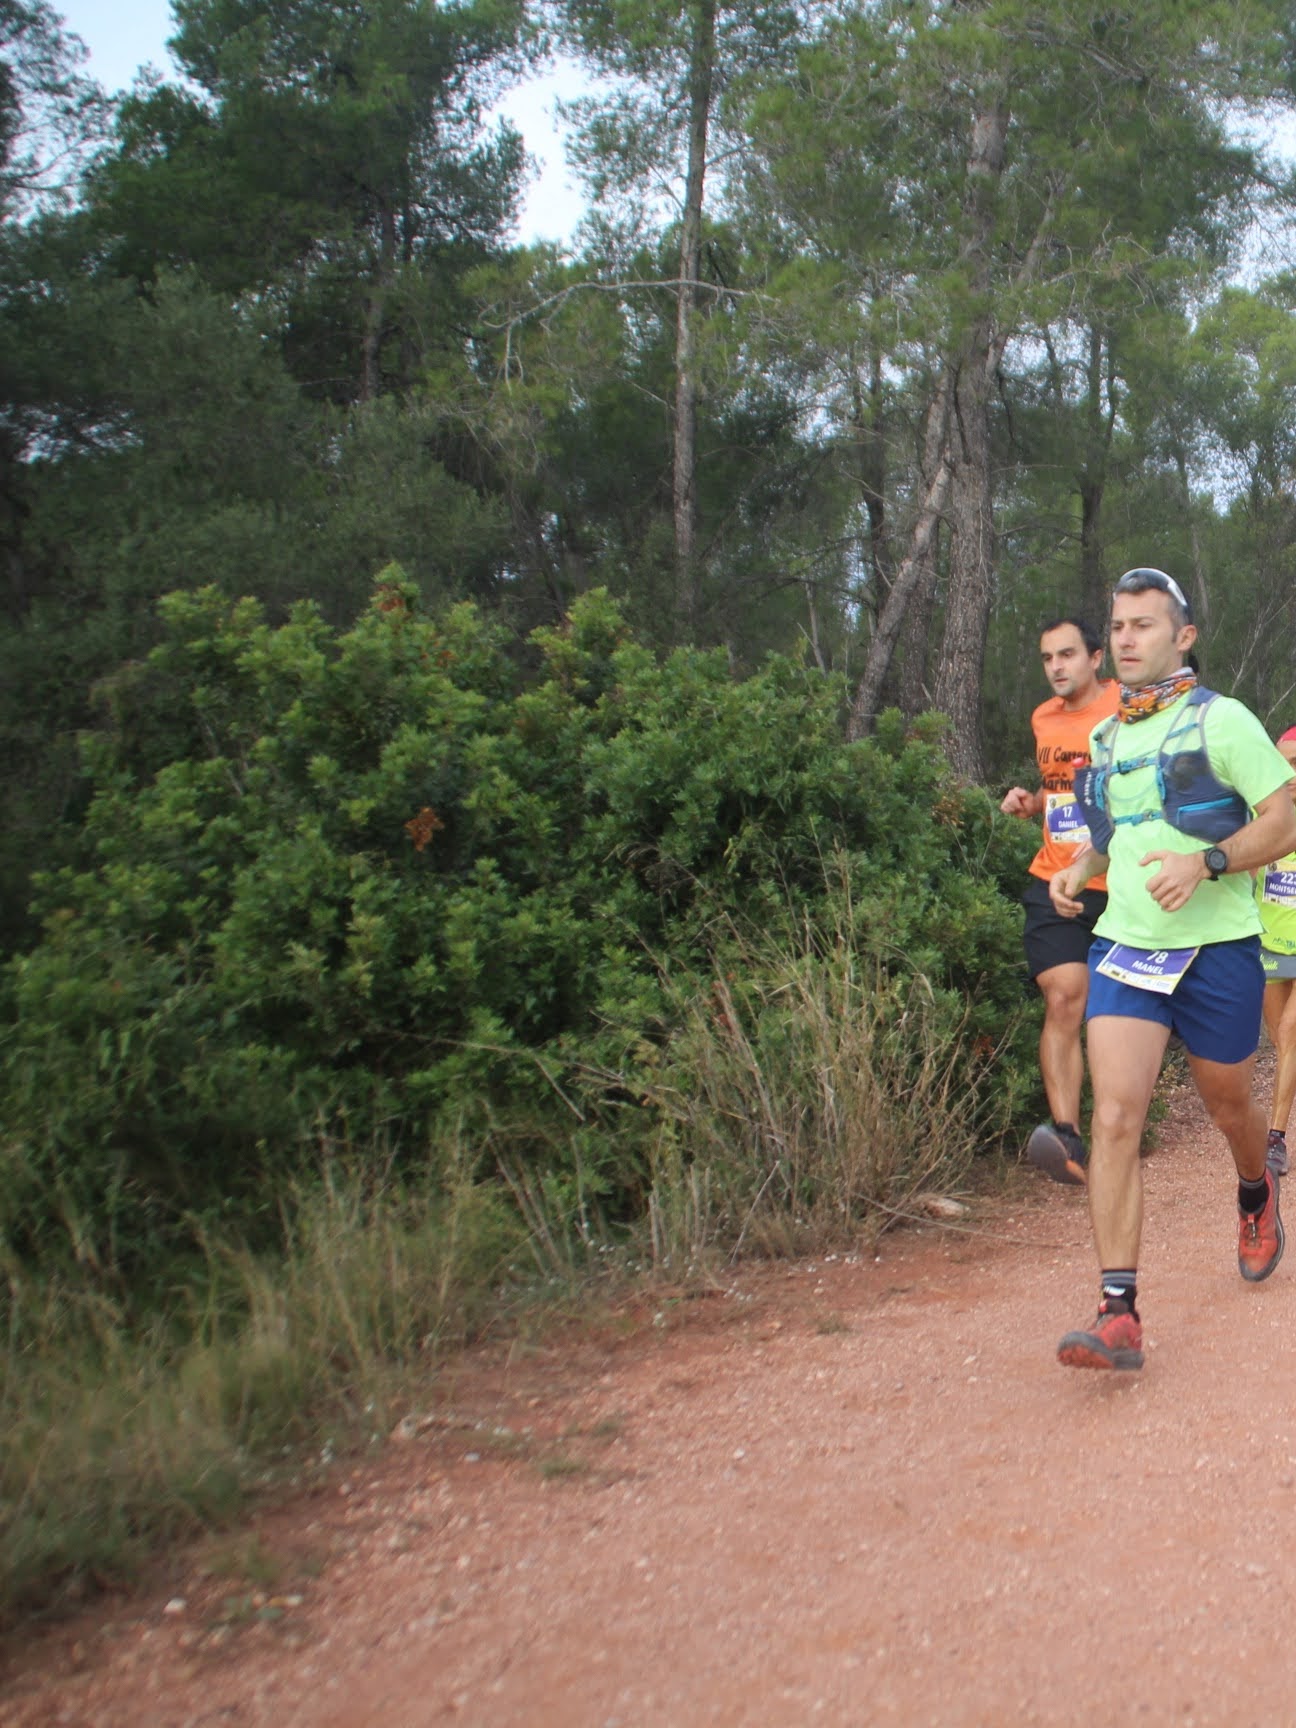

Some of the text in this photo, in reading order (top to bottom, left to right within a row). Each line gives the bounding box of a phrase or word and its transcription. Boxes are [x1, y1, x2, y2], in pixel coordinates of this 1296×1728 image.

[1062, 806, 1073, 818] 17
[1058, 820, 1078, 829] DANIEL
[1146, 950, 1169, 964] 78
[1131, 960, 1164, 975] MANEL
